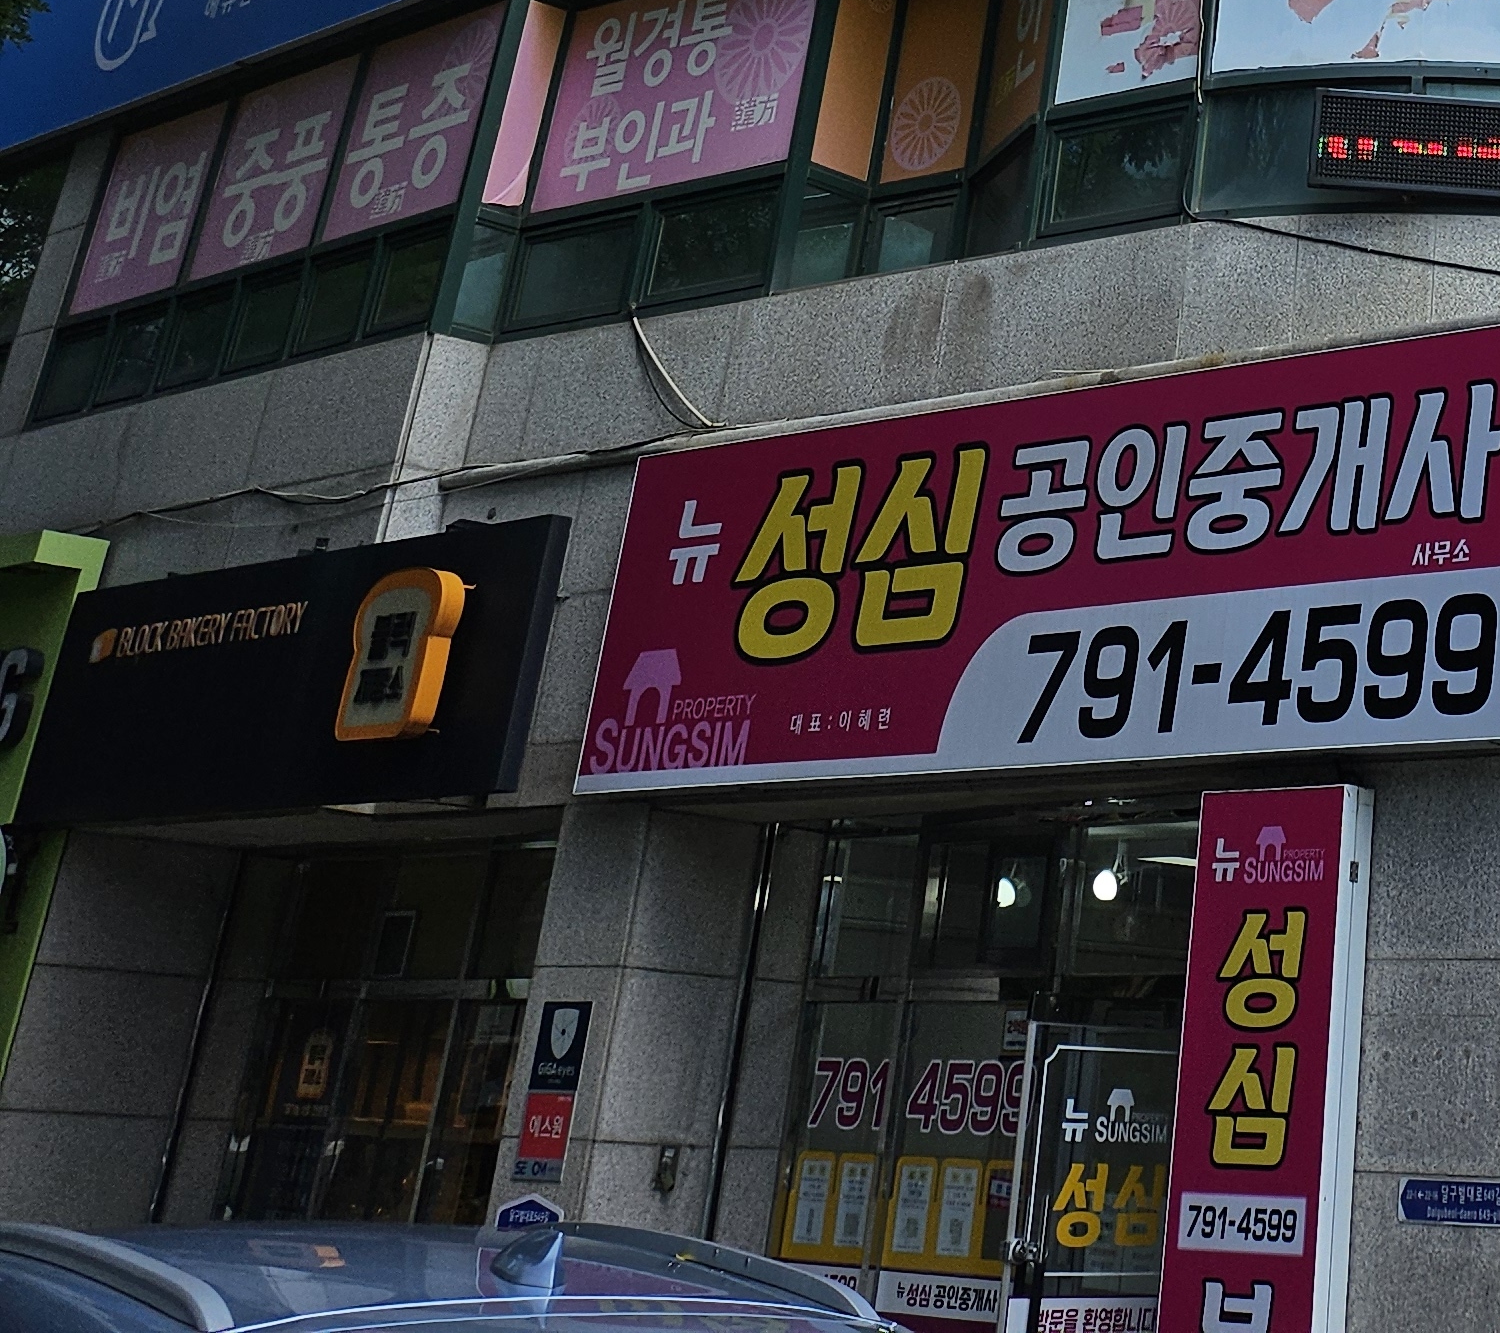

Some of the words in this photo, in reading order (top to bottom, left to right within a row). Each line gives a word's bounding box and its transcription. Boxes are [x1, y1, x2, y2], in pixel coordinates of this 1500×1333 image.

[344, 63, 473, 209] 통증
[559, 89, 717, 192] 부인과
[223, 111, 332, 248] 중풍
[105, 151, 206, 266] 비염
[669, 498, 724, 587] 뉴
[734, 448, 986, 659] 성심
[1411, 537, 1471, 568] 사무소
[116, 621, 168, 658] BLOCK
[1017, 592, 1498, 745] 791-4599
[672, 694, 757, 721] PROPERTY
[589, 717, 751, 775] SUNGSIM
[1211, 837, 1241, 883] 뉴
[1243, 855, 1325, 884] SUNGSIM
[1282, 847, 1326, 860] PROPERTY
[1208, 909, 1307, 1166] 성심
[807, 1057, 891, 1131] 791
[529, 1115, 564, 1138] 에스원
[1061, 1098, 1089, 1142] 뉴
[1094, 1116, 1167, 1144] SUNGSIM
[1052, 1162, 1168, 1248] 성심
[1186, 1203, 1299, 1245] 791-4599
[933, 1284, 999, 1313] 공인중개사
